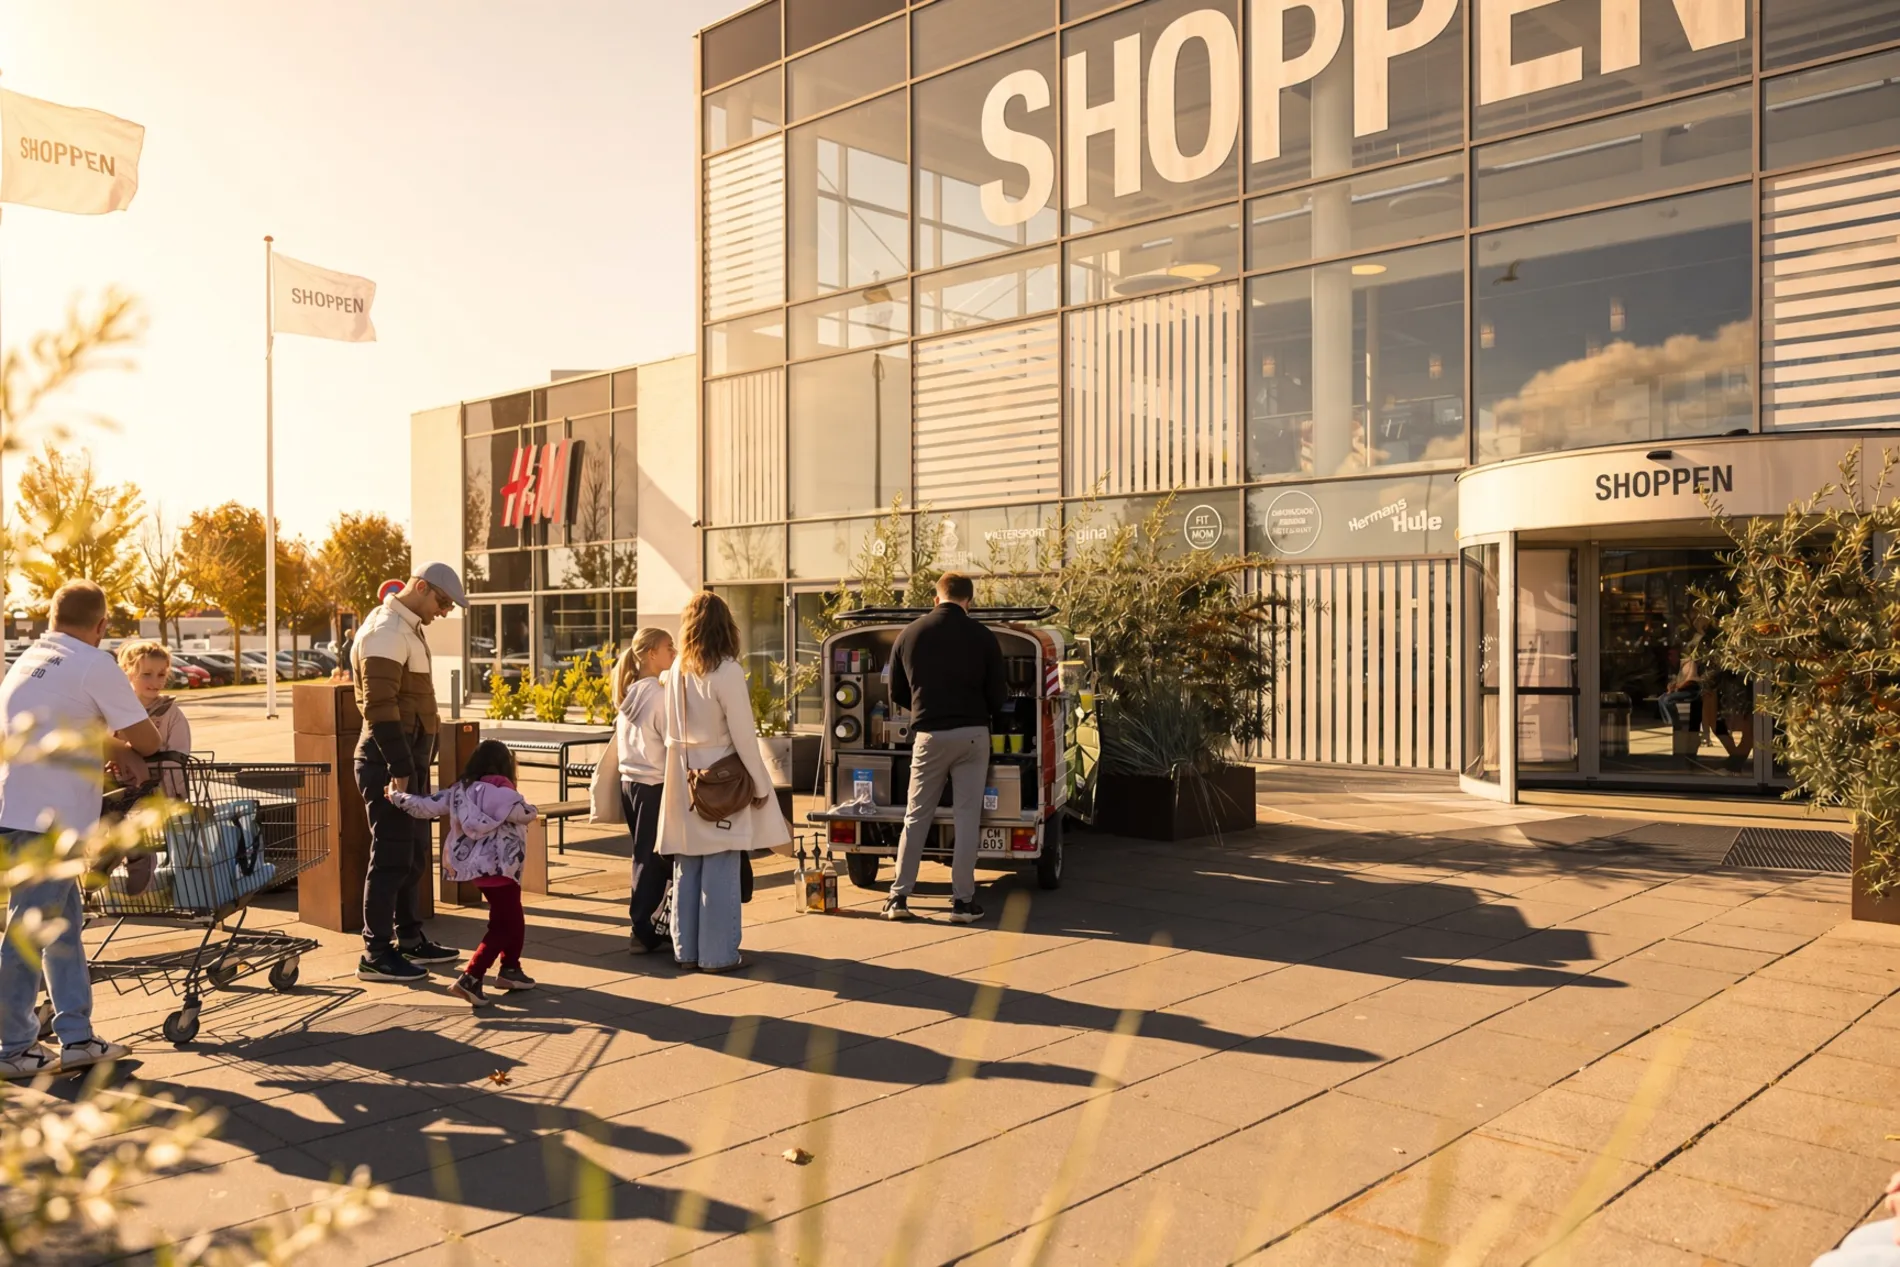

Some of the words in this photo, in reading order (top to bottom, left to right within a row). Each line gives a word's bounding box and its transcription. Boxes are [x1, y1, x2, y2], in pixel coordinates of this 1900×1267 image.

[20, 136, 115, 177] SHOPPEN
[291, 287, 364, 314] SHOPPEN
[1595, 465, 1733, 501] SHOPPEN
[1195, 514, 1209, 525] FIT
[1348, 498, 1407, 532] Hermans
[1391, 509, 1442, 532] Hule
[1191, 529, 1214, 541] MOM
